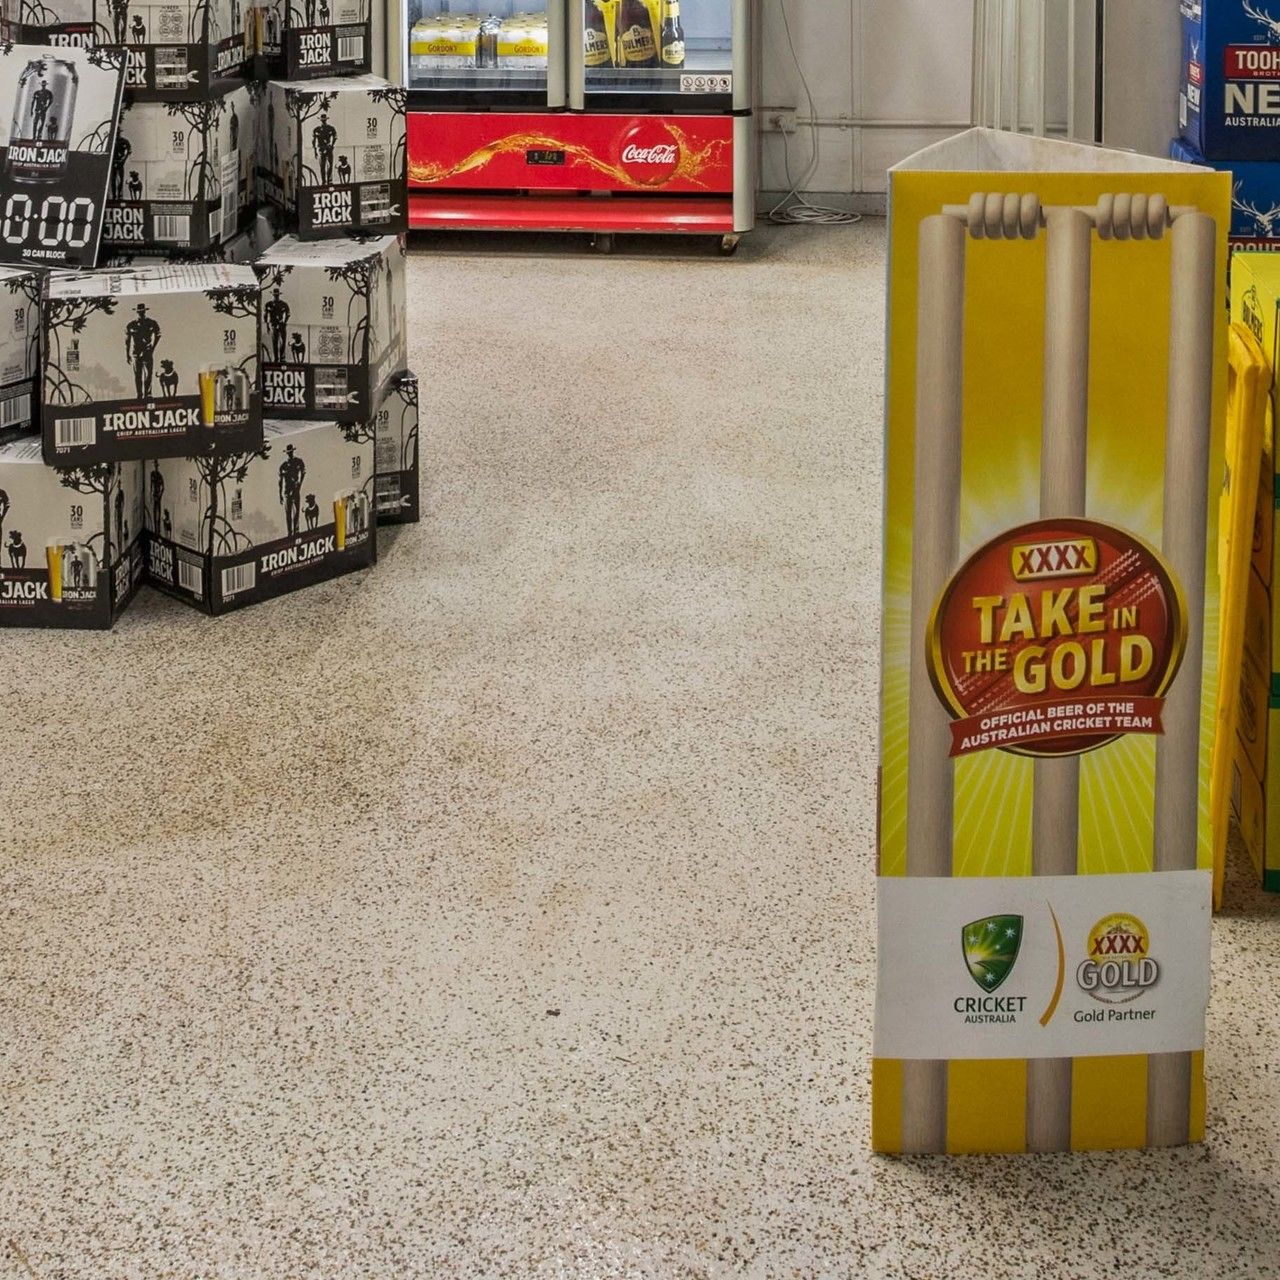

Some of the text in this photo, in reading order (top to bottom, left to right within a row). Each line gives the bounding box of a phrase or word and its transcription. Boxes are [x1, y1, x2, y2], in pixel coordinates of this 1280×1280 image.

[299, 35, 331, 50] IRON
[299, 50, 331, 64] JACK
[622, 144, 677, 163] Coca-Cola
[22, 248, 66, 259] 30 CAN BLOCK
[103, 408, 200, 431] IRON JACK
[1017, 545, 1087, 577] XXXX
[972, 584, 1137, 645] TAKE IN
[962, 633, 1155, 695] THE GOLD
[981, 703, 1134, 730] OFFICIAL BEER OF THE
[961, 717, 1152, 749] AUSTRALIAN CRICKET TEAM
[1076, 958, 1160, 992] GOLD
[954, 997, 1027, 1013] CRICKET
[1074, 1008, 1156, 1023] Gold Partner
[964, 1015, 1016, 1024] AUSTRALIA
